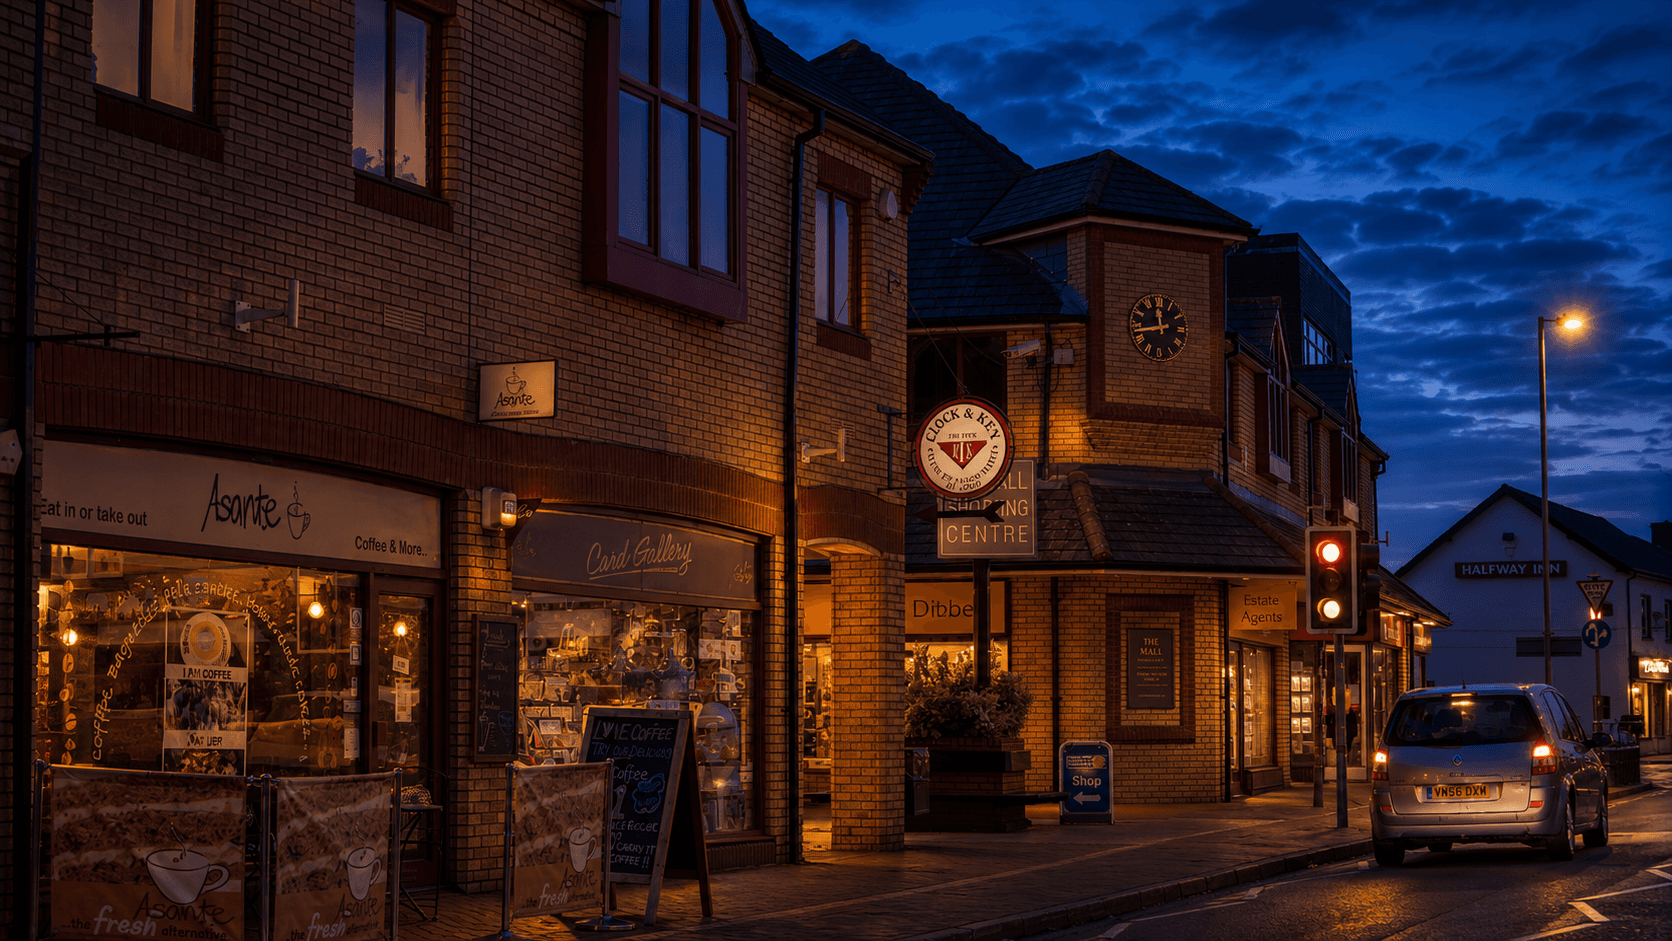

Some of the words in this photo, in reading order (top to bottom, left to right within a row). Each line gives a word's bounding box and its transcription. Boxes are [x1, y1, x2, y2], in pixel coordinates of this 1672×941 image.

[494, 392, 535, 409] Asante
[925, 408, 960, 442] CLOCK
[963, 407, 974, 419] &
[976, 412, 1001, 440] KEY
[201, 473, 281, 531] Asante
[64, 501, 76, 518] in
[79, 507, 94, 520] or
[97, 506, 124, 524] take
[127, 511, 148, 526] out
[946, 525, 1028, 543] CENTRE
[355, 535, 387, 553] Coffee
[389, 540, 397, 554] &
[586, 539, 630, 574] Card
[632, 533, 692, 576] Gallery
[1461, 564, 1527, 576] HALFWAY
[1244, 594, 1279, 606] Estate
[1241, 611, 1283, 626] Agents
[1143, 637, 1160, 646] THE
[1140, 647, 1163, 656] MALL
[183, 667, 186, 678] I
[202, 669, 232, 680] COFFEE
[1072, 775, 1102, 789] Shop
[559, 867, 598, 891] Asante
[132, 891, 235, 926] Asante
[333, 893, 383, 923] Asante
[93, 904, 157, 937] fresh
[306, 911, 347, 941] fresh
